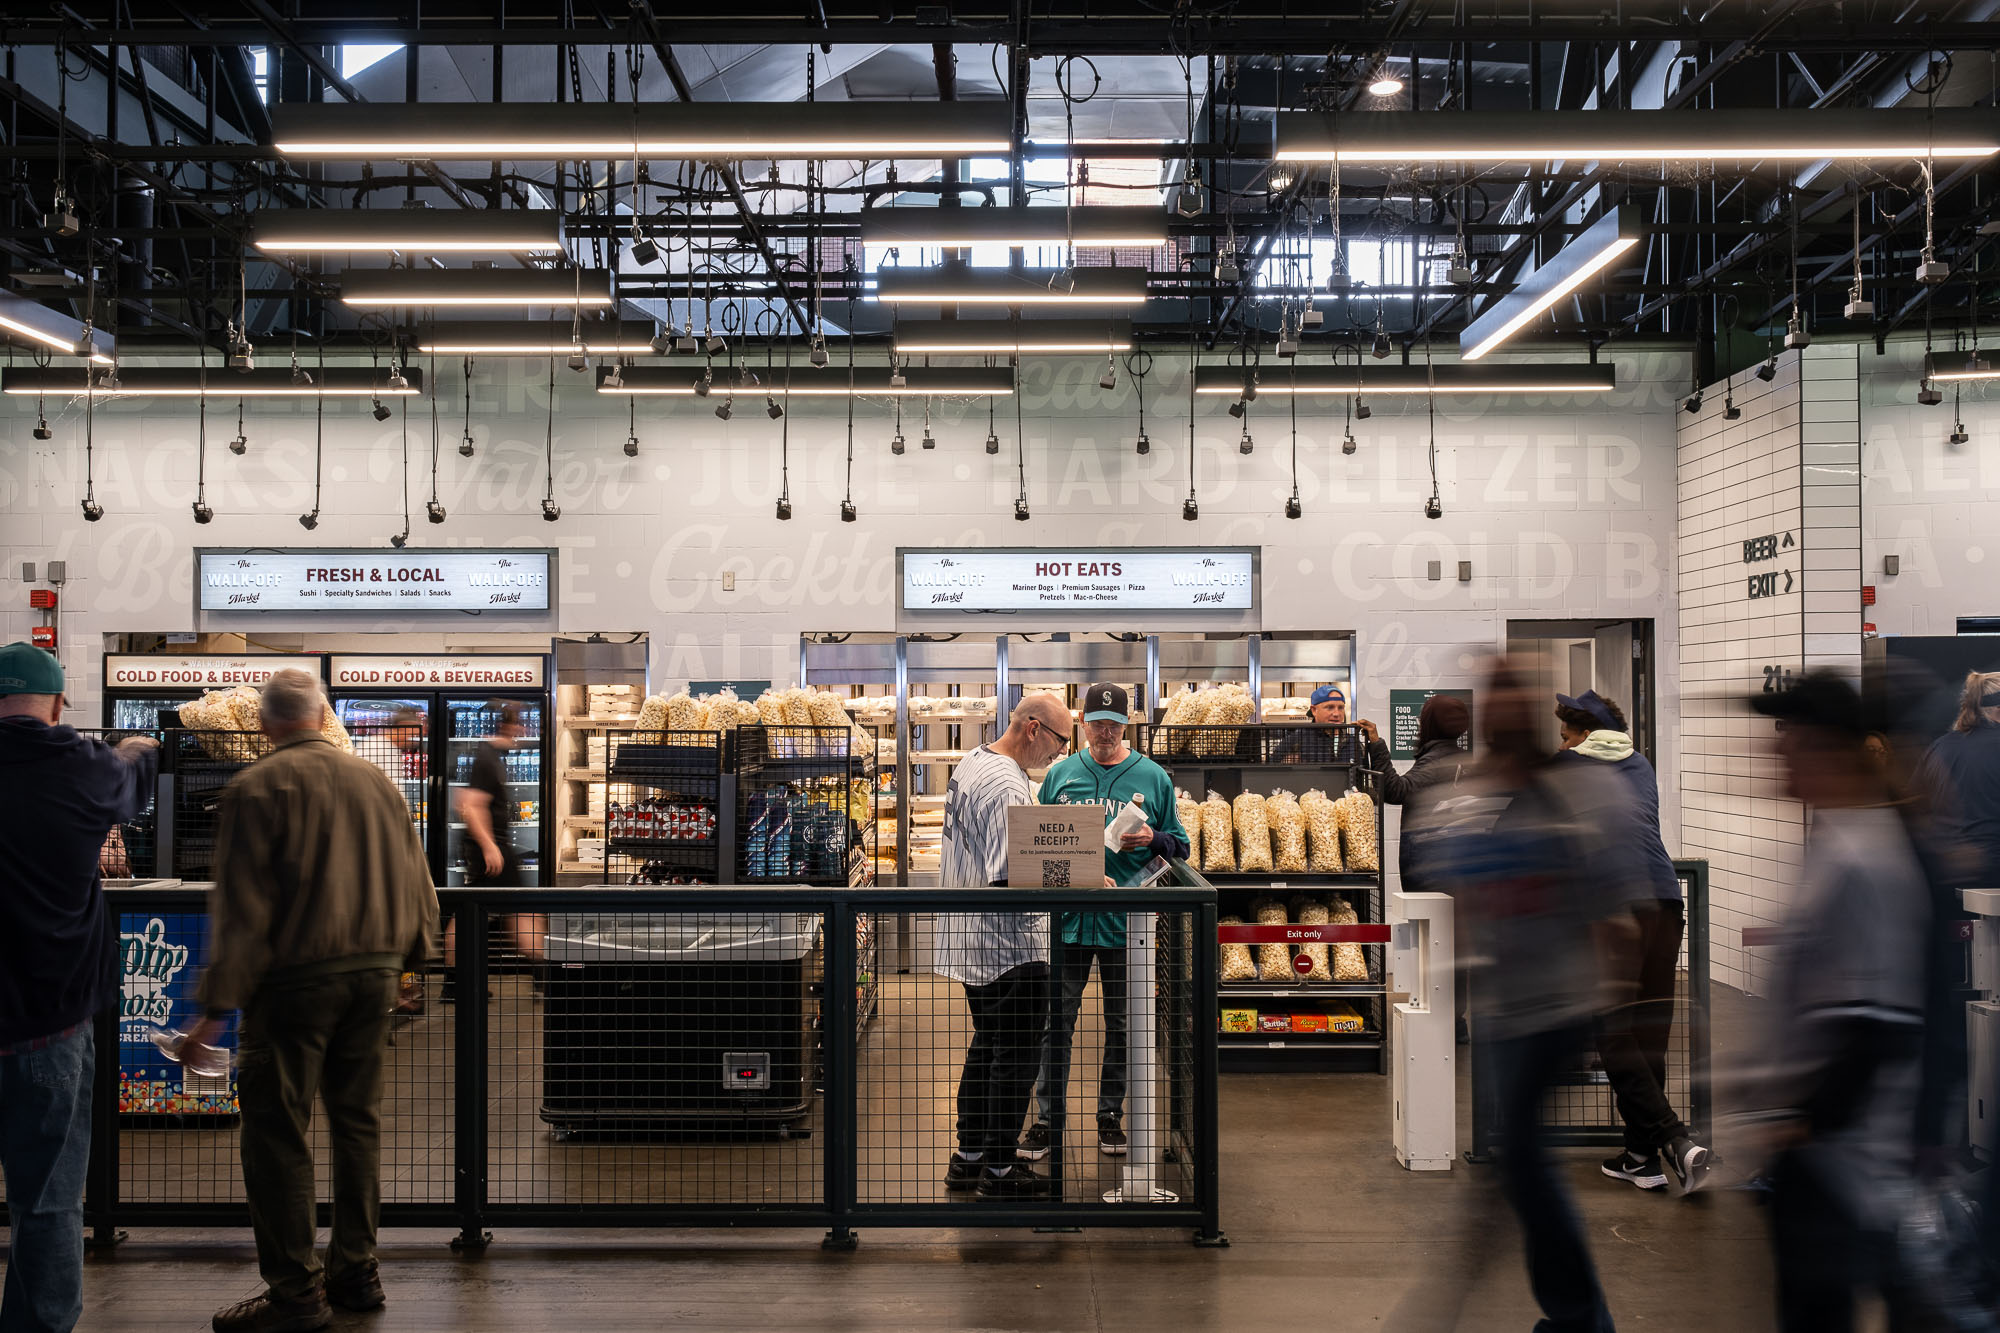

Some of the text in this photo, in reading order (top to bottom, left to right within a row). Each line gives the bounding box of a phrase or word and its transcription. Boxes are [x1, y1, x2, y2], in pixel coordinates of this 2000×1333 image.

[690, 437, 921, 508] JUICE
[992, 437, 1241, 506] HARD
[1272, 436, 1642, 505] SELTZER
[1743, 534, 1778, 564] BEER
[237, 559, 251, 569] The
[498, 558, 512, 568] The
[940, 558, 954, 568] The
[1035, 562, 1122, 577] HOT EATS
[1202, 558, 1216, 568] The
[1332, 530, 1575, 601] COLD
[206, 573, 283, 588] WALK-OFF
[306, 568, 445, 583] FRESH & LOCAL
[468, 572, 544, 588] WALK-OFF
[910, 572, 986, 587] WALK-OFF
[1171, 572, 1248, 587] WALK-OFF
[1038, 584, 1054, 592] Dogs
[1091, 584, 1121, 592] Sausages
[1748, 571, 1778, 600] EXIT
[228, 592, 260, 605] Market
[299, 589, 451, 598] Sushi Specialty Sandwiches Salads Snacks
[489, 592, 521, 605] Market
[931, 591, 964, 604] Market
[1192, 591, 1225, 604] Market
[116, 670, 157, 683] COLD
[162, 670, 203, 683] FOOD
[207, 670, 218, 683] &
[340, 671, 533, 683] COLD FOOD & BEVERAGES
[1039, 823, 1075, 833] NEED A
[1034, 836, 1080, 846] RECEIPT?
[1287, 930, 1322, 940] Exit only
[126, 1025, 149, 1033] ICE
[1263, 1019, 1288, 1028] Skittles
